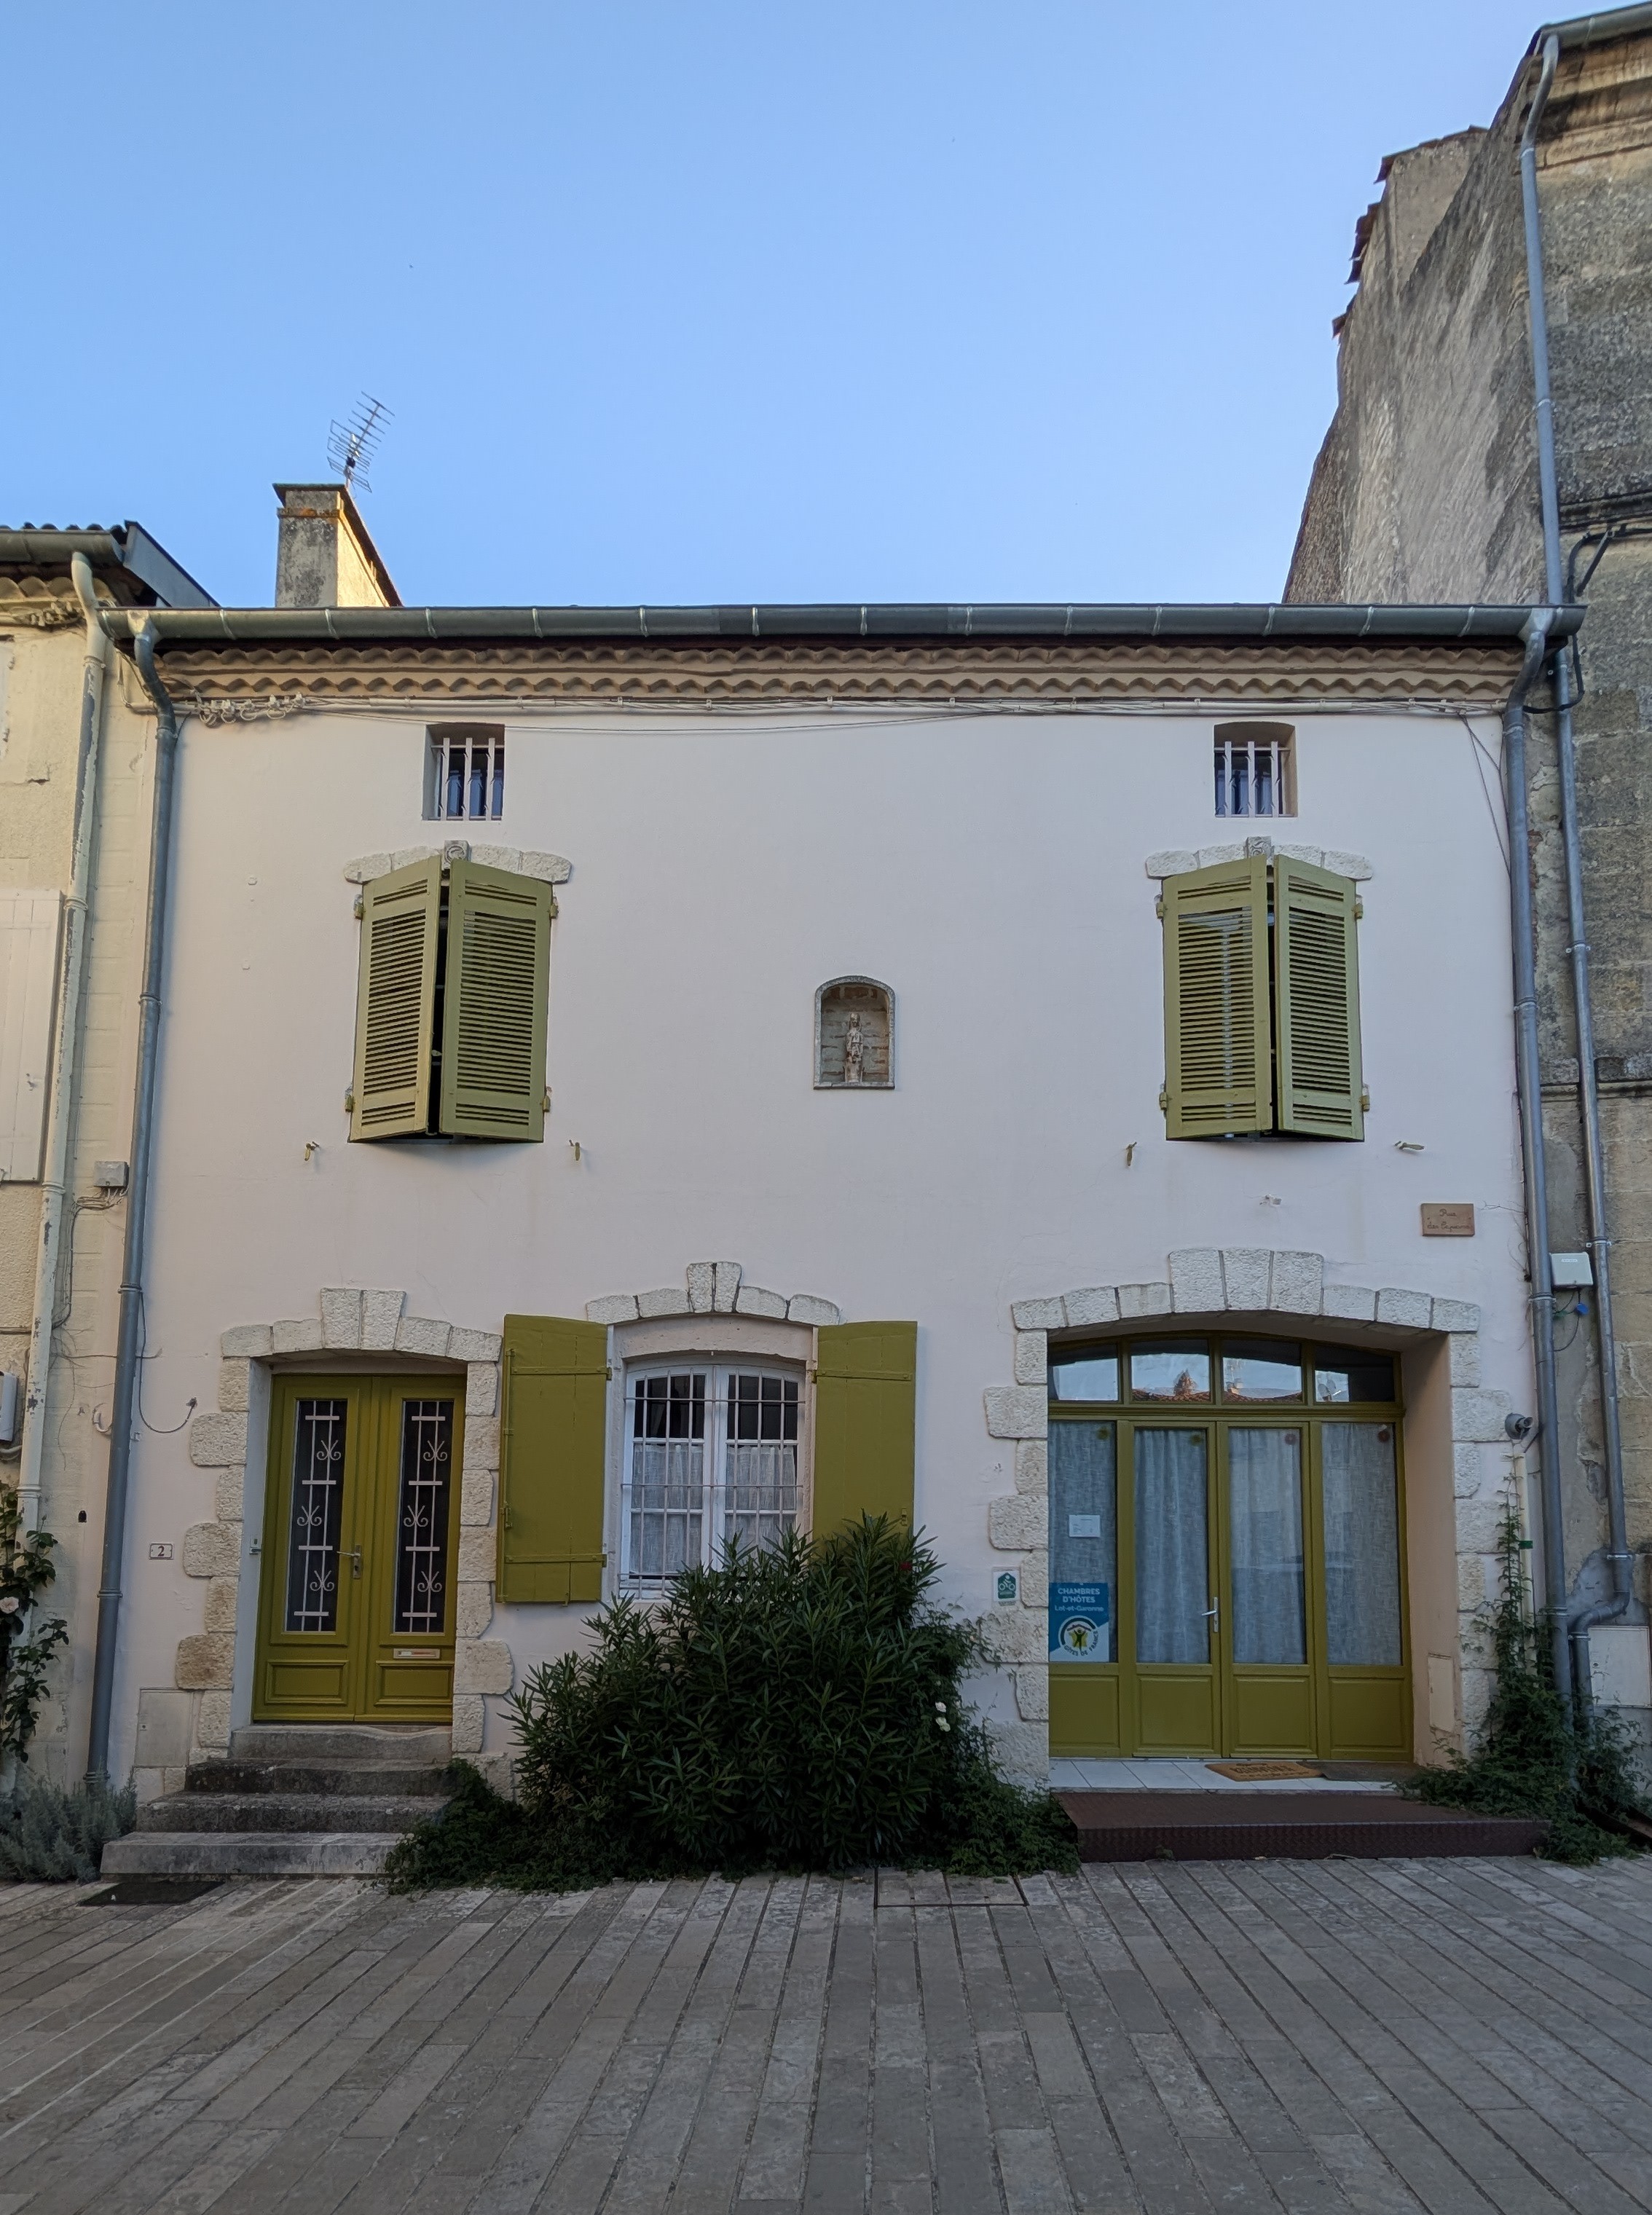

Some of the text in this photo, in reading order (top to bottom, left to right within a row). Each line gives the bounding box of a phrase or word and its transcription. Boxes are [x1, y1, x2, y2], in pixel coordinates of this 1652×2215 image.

[1439, 1208, 1458, 1217] Rue
[157, 1545, 165, 1557] 2
[1062, 1594, 1096, 1603] D'HÔTES
